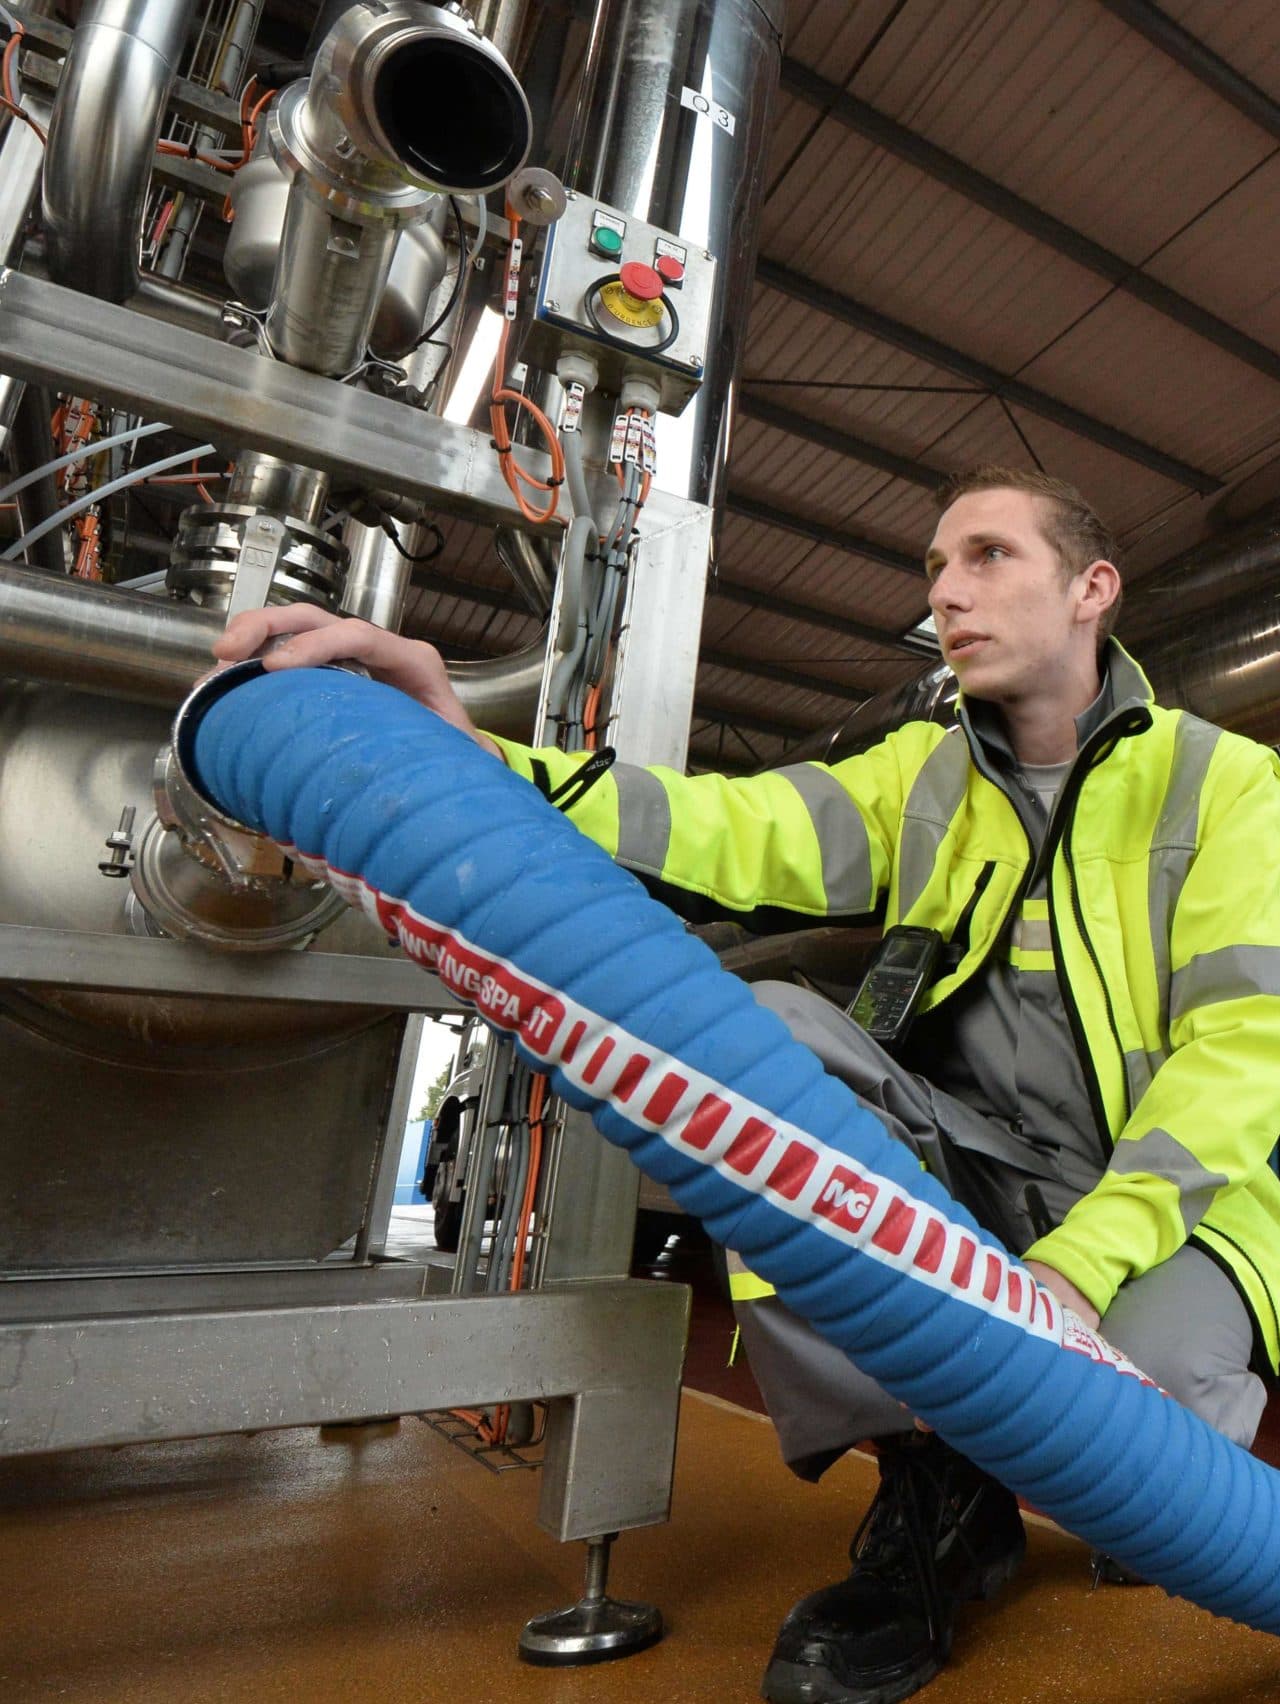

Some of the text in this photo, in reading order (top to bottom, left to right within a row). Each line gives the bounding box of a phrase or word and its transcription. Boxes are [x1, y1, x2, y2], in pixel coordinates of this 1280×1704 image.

[692, 94, 729, 128] Q 3
[822, 1178, 871, 1219] IVG
